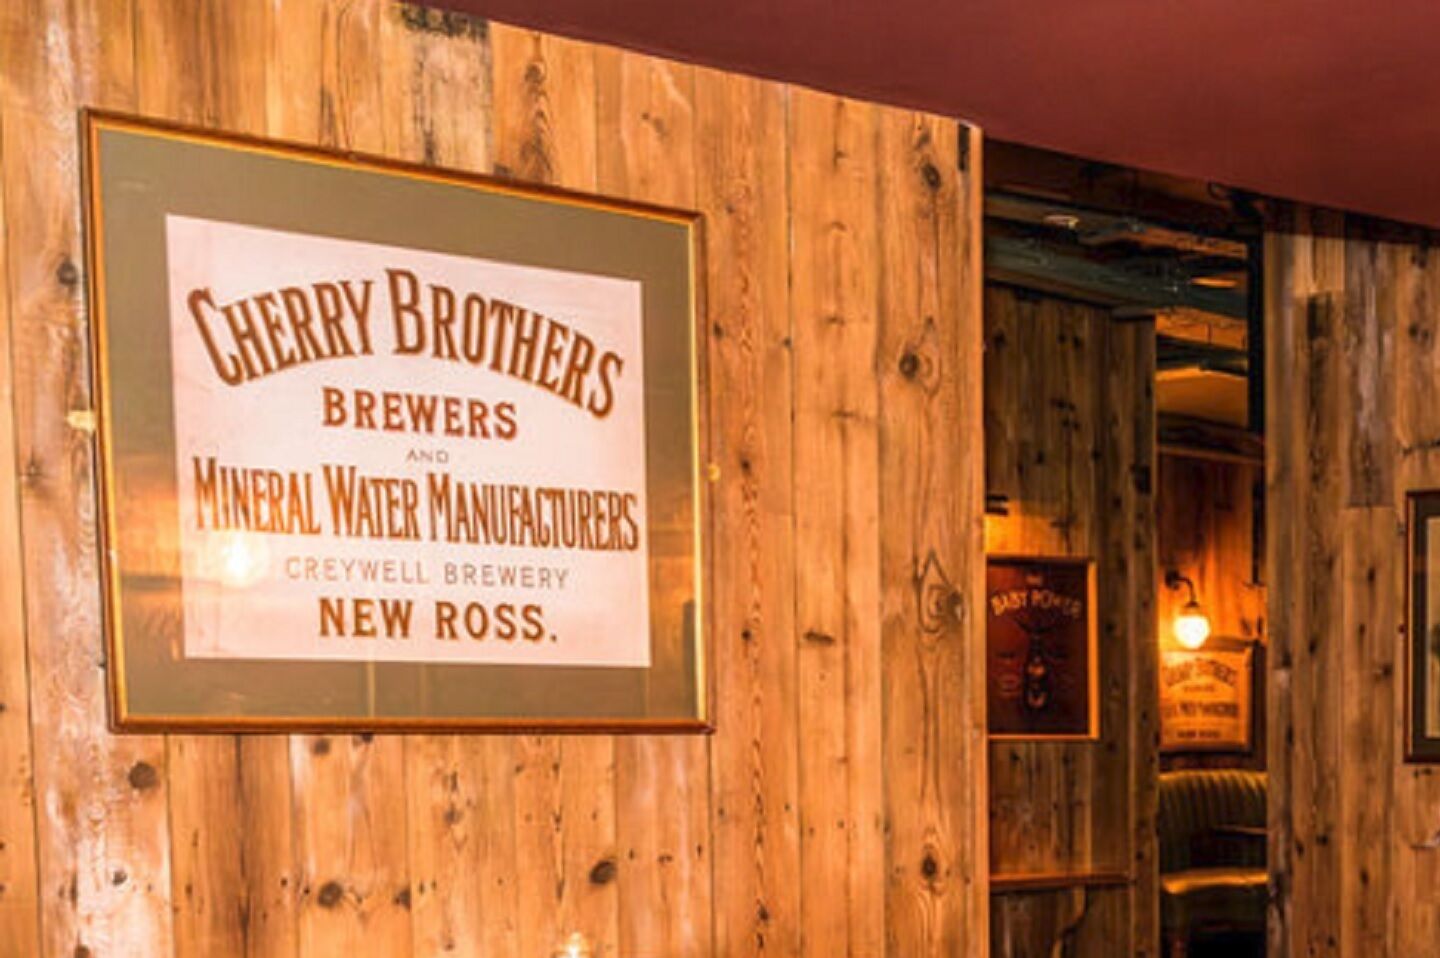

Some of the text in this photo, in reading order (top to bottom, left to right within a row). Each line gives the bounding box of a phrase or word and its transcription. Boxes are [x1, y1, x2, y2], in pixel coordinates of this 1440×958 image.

[187, 268, 624, 419] CHERRY BROTHERS
[322, 387, 517, 440] BREWERS
[406, 449, 449, 464] AND
[192, 456, 639, 551] MINERAL WATER MANUFACTURERS
[443, 562, 569, 590] BREWERY
[318, 597, 558, 643] NEW ROSS.
